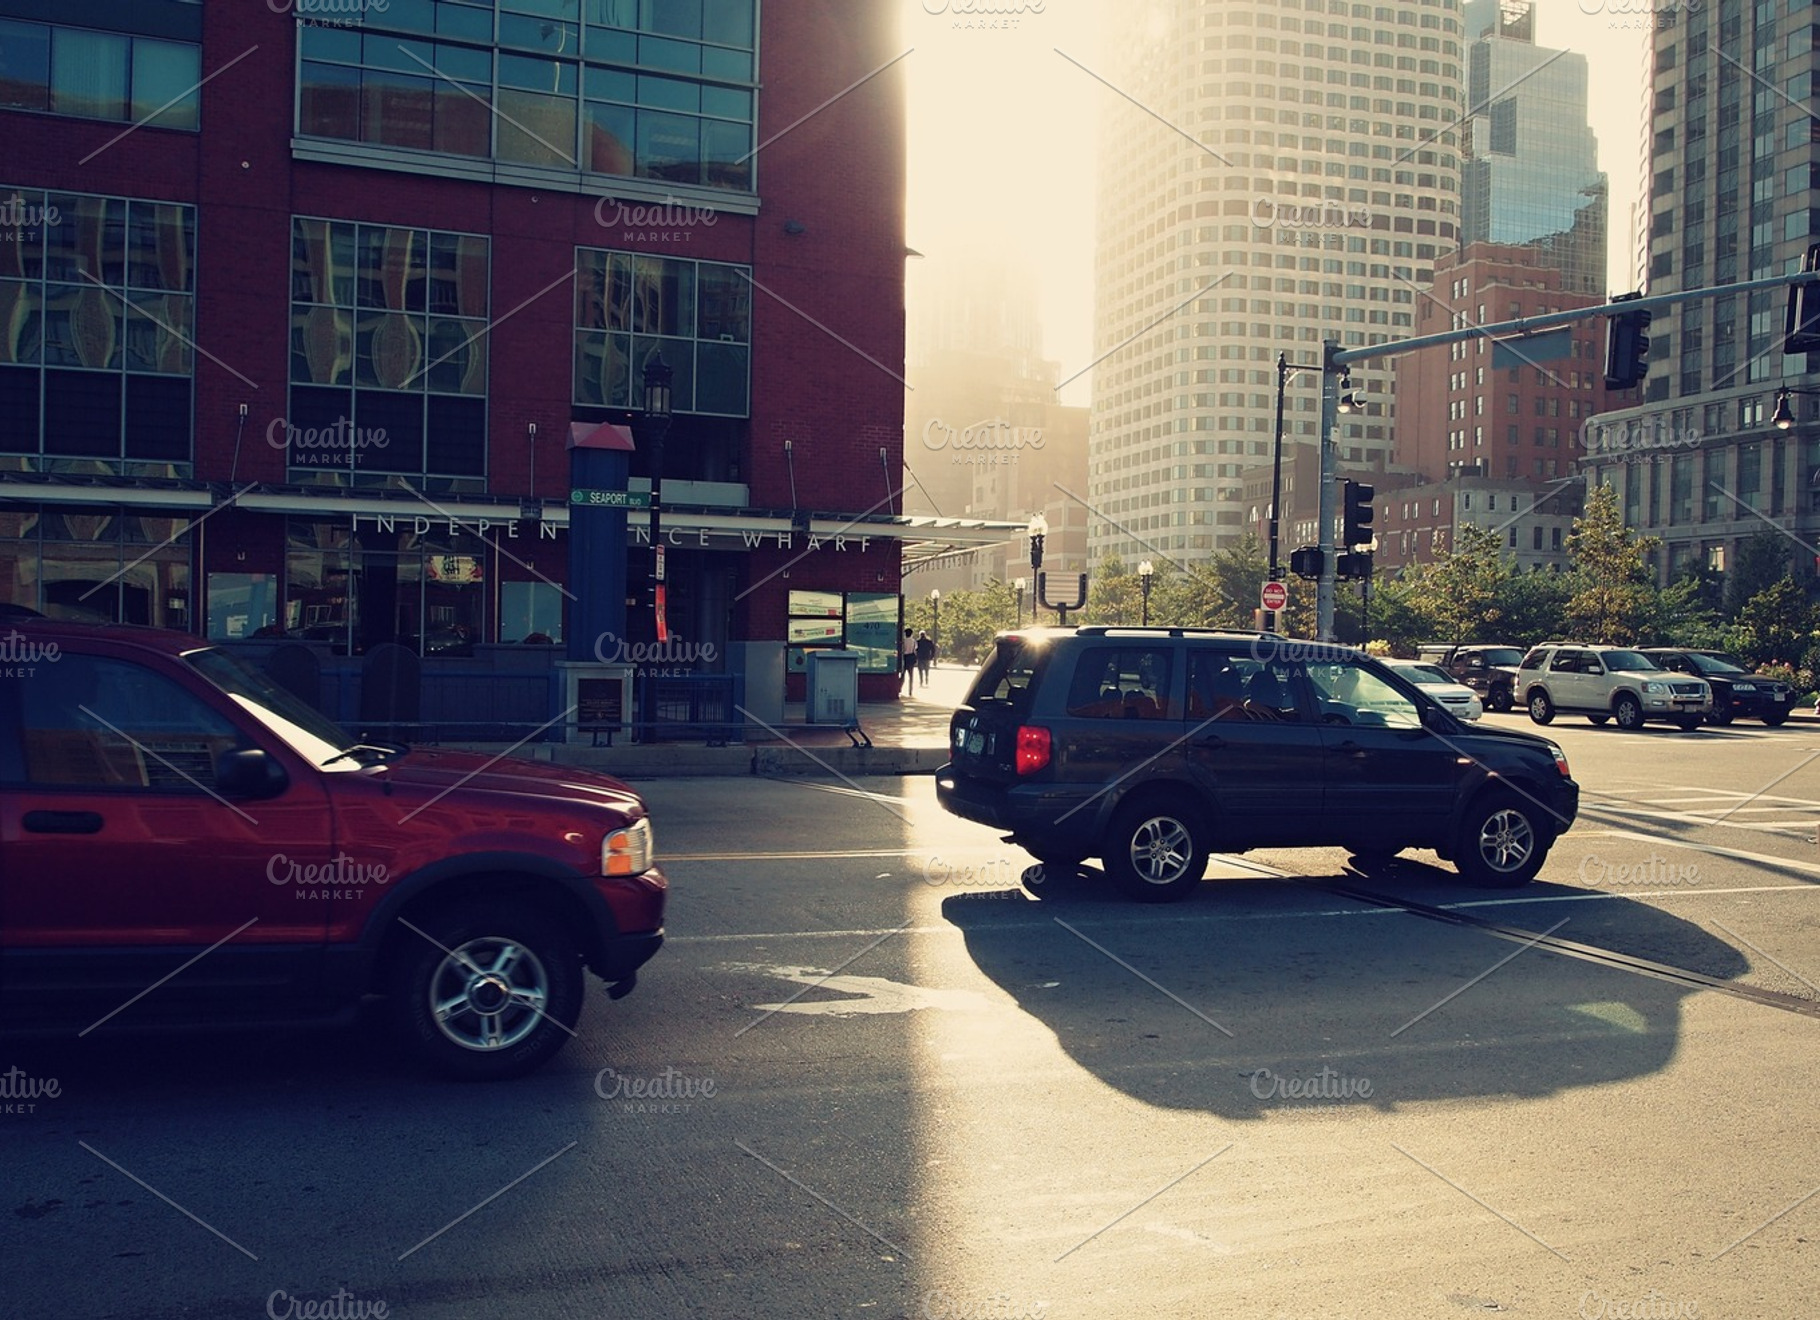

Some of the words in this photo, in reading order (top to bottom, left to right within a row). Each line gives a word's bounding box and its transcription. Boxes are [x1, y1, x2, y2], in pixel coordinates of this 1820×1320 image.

[590, 492, 627, 504] SEAPORT
[353, 514, 709, 546] INDEPENNCE
[743, 530, 871, 553] WHARF
